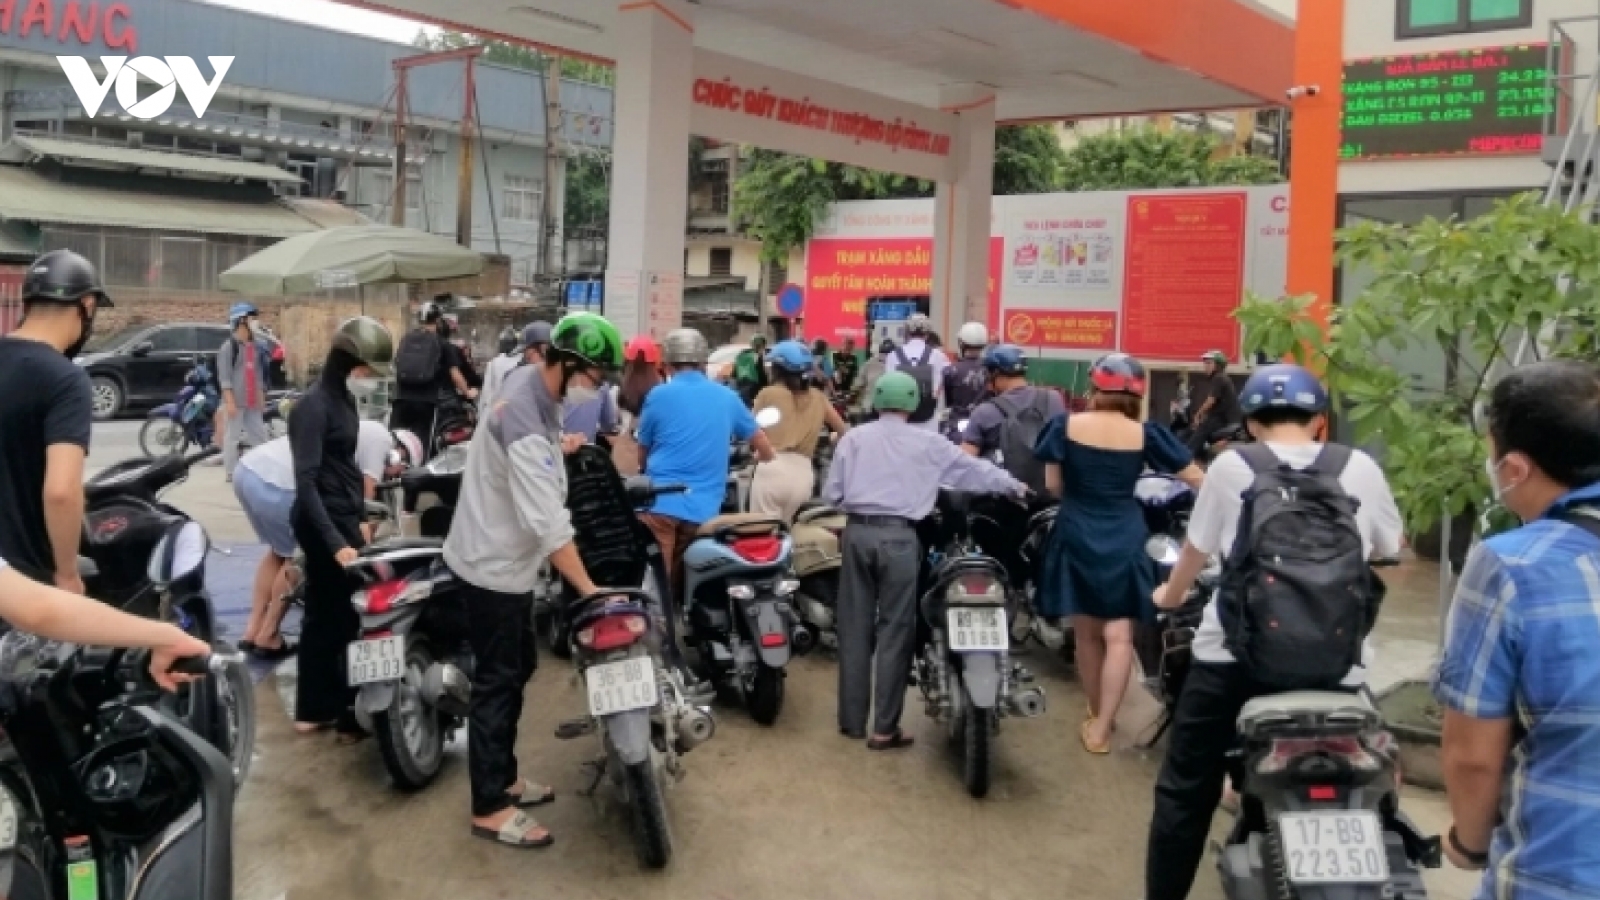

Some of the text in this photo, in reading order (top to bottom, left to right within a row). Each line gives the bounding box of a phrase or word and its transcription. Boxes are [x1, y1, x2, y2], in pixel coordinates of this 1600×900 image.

[693, 75, 741, 112] CHÚC
[744, 86, 776, 119] QUÝ
[777, 97, 829, 130] KHÁCH
[1295, 817, 1366, 845] 17-B9
[1290, 848, 1380, 877] 223.50
